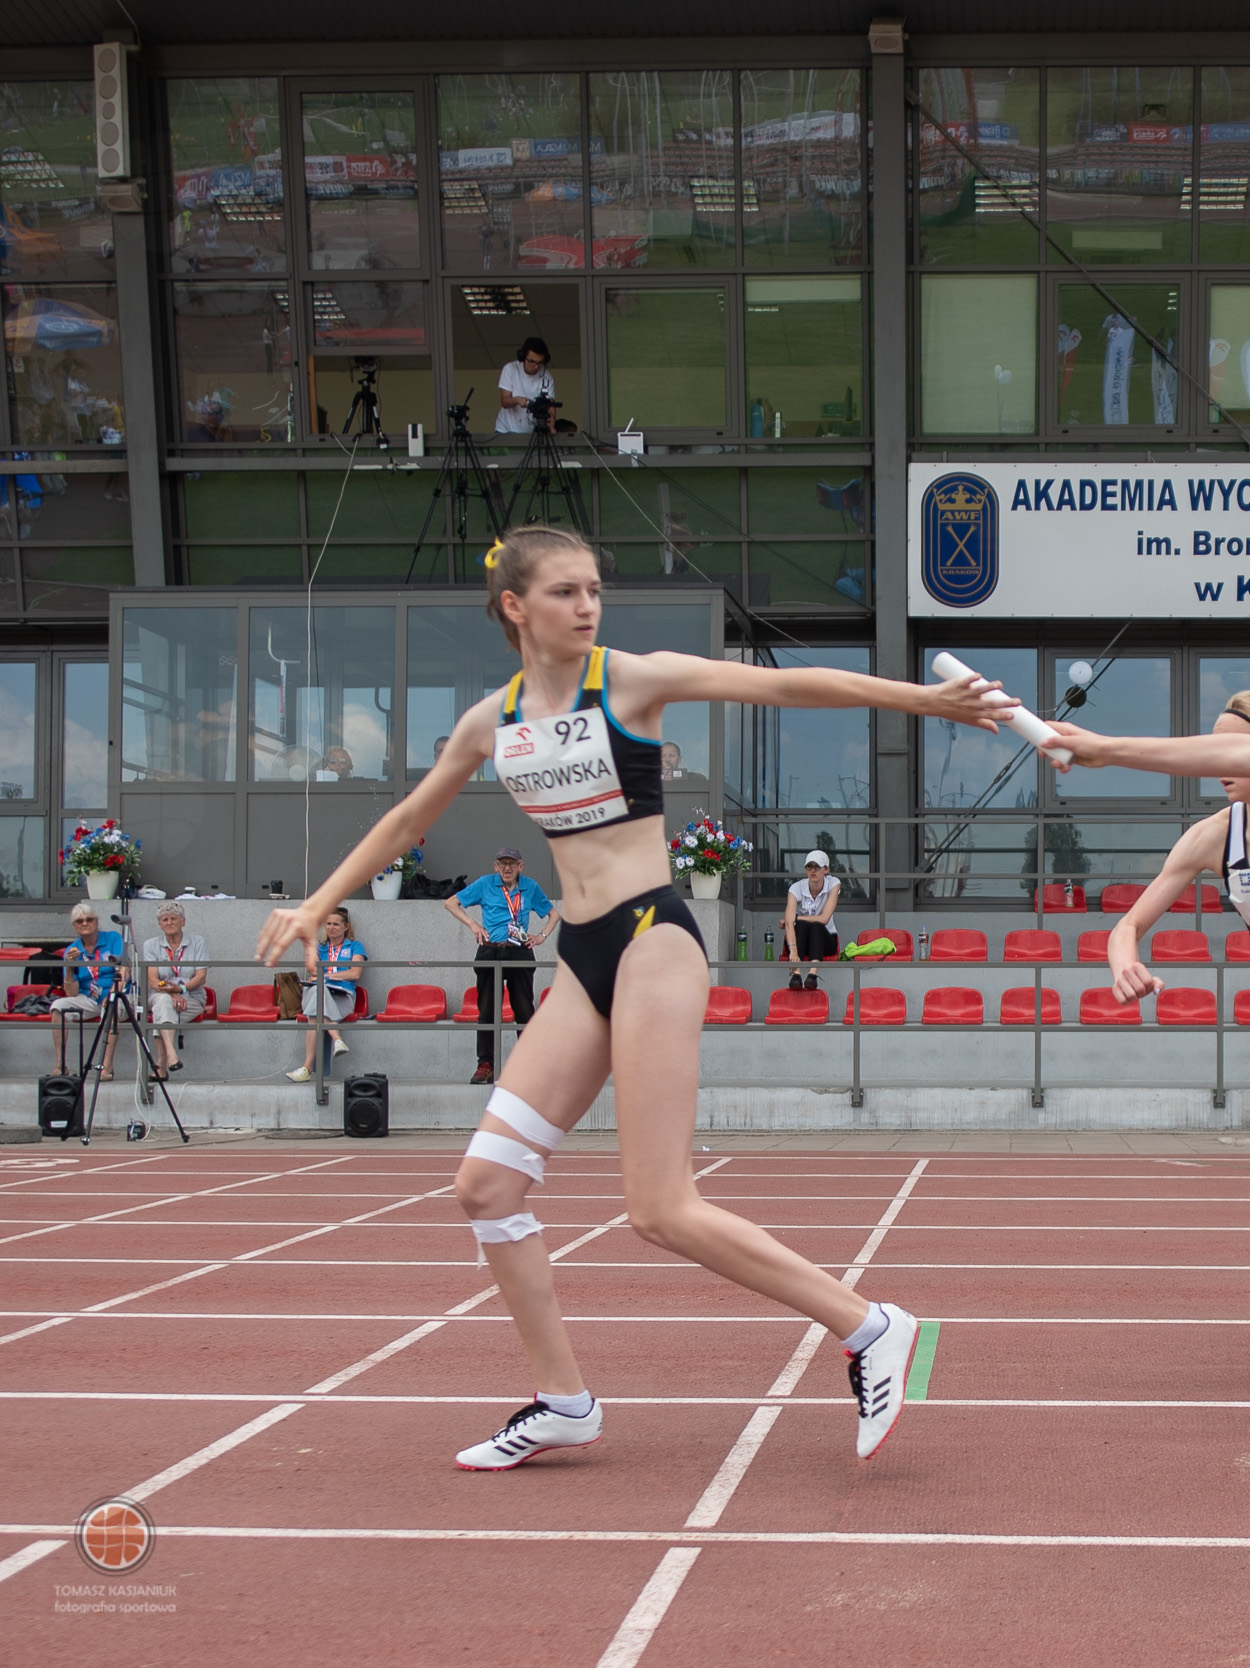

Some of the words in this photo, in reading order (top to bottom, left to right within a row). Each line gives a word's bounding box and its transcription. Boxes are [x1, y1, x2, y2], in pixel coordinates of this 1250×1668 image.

[1011, 478, 1178, 512] AKADEMIA
[942, 511, 980, 520] AWF
[1137, 530, 1181, 556] im.
[1194, 582, 1224, 602] w
[555, 717, 592, 745] 92
[505, 758, 612, 793] OSTROWSKA
[575, 807, 606, 823] 2019
